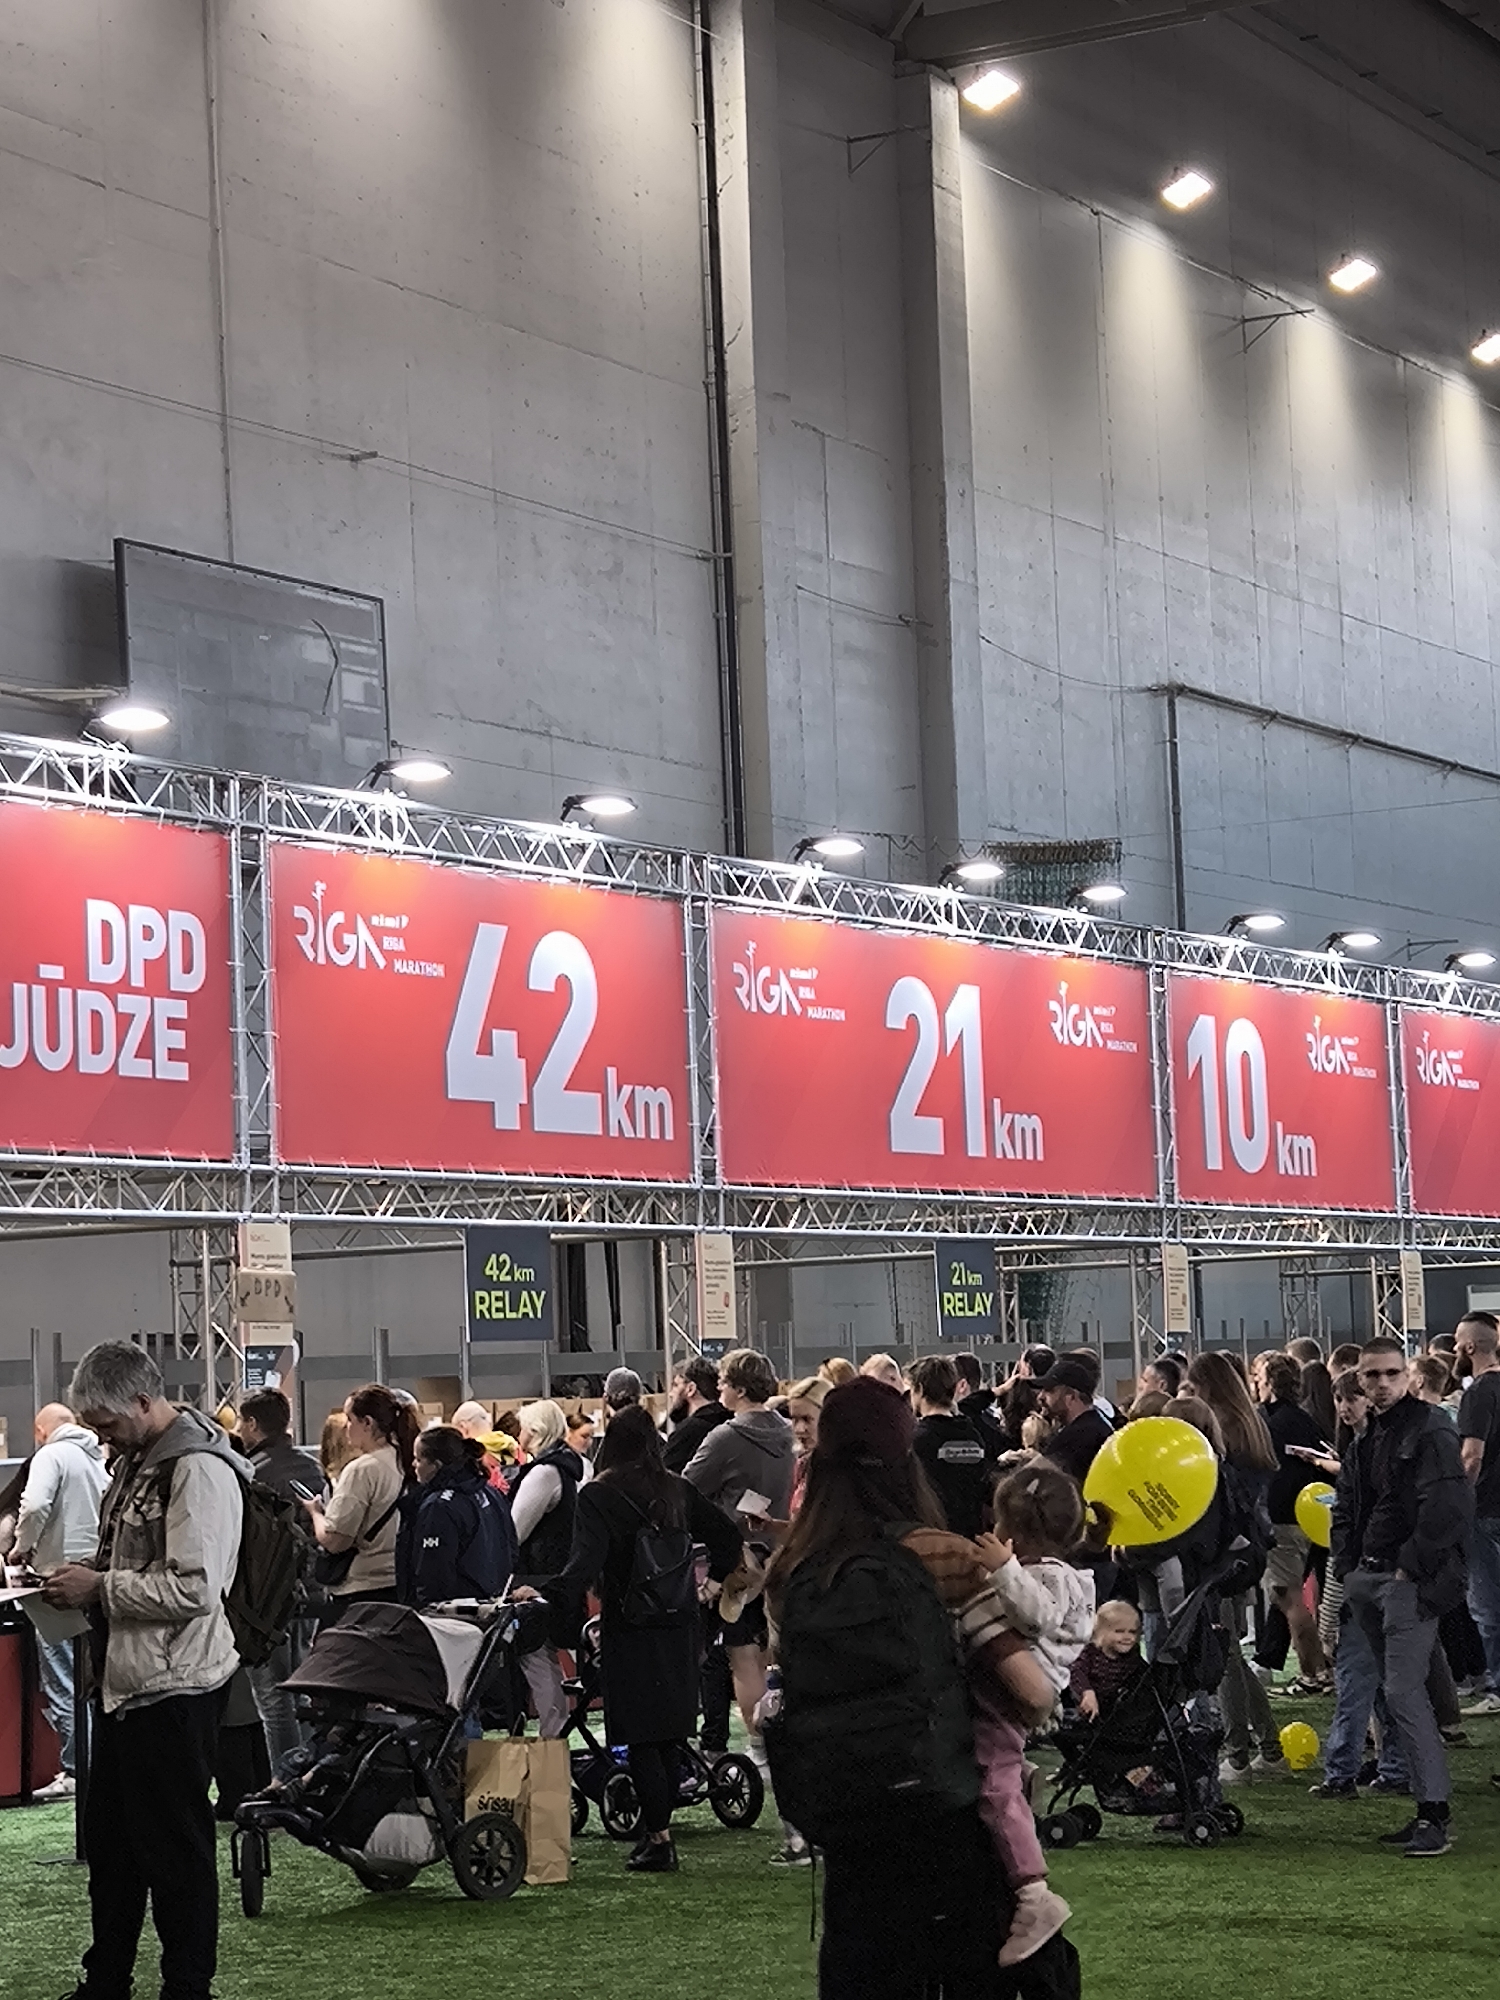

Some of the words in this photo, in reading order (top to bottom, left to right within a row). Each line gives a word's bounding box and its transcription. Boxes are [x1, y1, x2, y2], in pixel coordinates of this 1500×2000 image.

[86, 898, 207, 994] DPD
[393, 958, 446, 978] MARATHON
[0, 963, 189, 1082] JŪDZE
[445, 921, 603, 1136] 42
[606, 1066, 675, 1141] km
[885, 974, 987, 1158] 21
[992, 1097, 1045, 1161] km
[1187, 1014, 1270, 1174] 10
[1276, 1121, 1318, 1178] km
[484, 1253, 512, 1281] 42
[513, 1263, 535, 1282] km
[950, 1261, 966, 1286] 21
[967, 1269, 983, 1286] km
[254, 1277, 282, 1298] DPD
[474, 1290, 546, 1319] RELAY
[943, 1291, 994, 1317] RELAY
